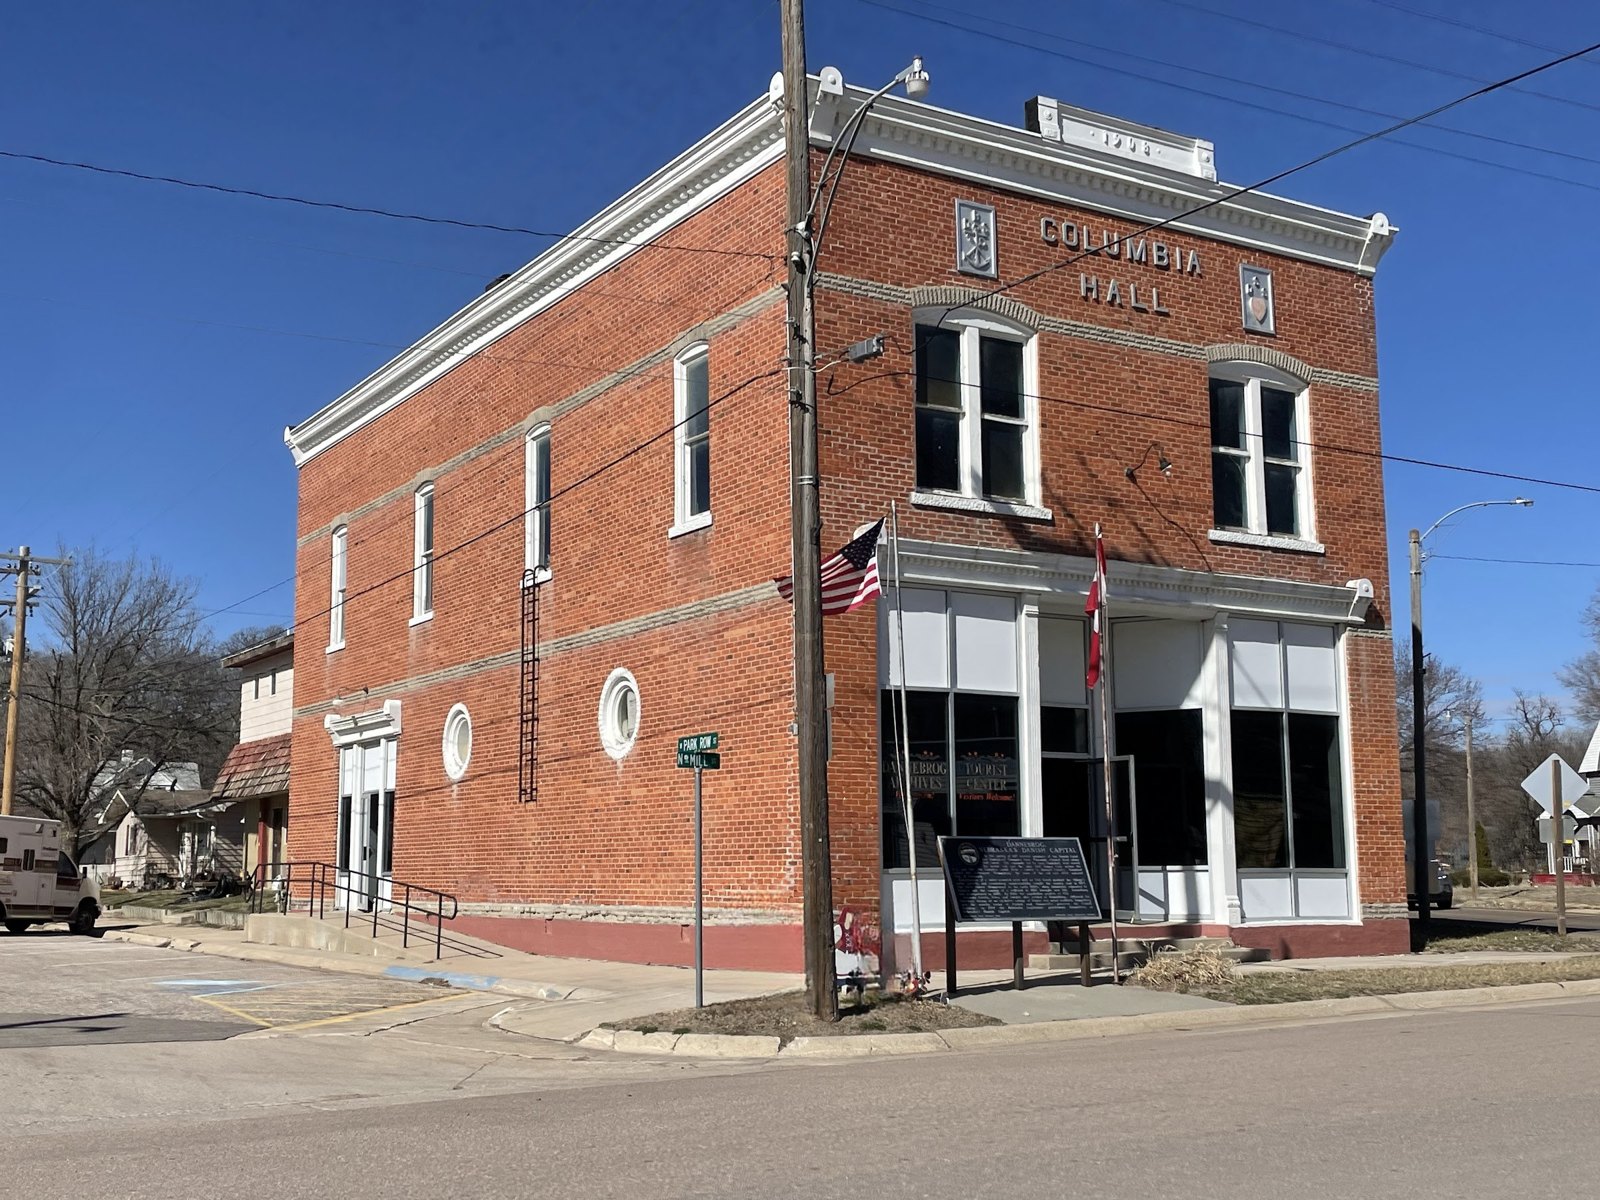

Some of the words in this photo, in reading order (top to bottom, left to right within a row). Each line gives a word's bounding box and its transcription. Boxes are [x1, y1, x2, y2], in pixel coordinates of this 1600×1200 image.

[1040, 217, 1202, 275] COLUMBIA
[1080, 272, 1170, 314] HALL
[683, 738, 698, 751] PARK
[700, 736, 711, 749] ROW
[690, 754, 708, 766] MILL
[883, 761, 947, 775] DANEBROG
[965, 762, 1008, 776] TOURIST
[890, 776, 942, 790] AHIVES
[966, 778, 1008, 791] CENTER
